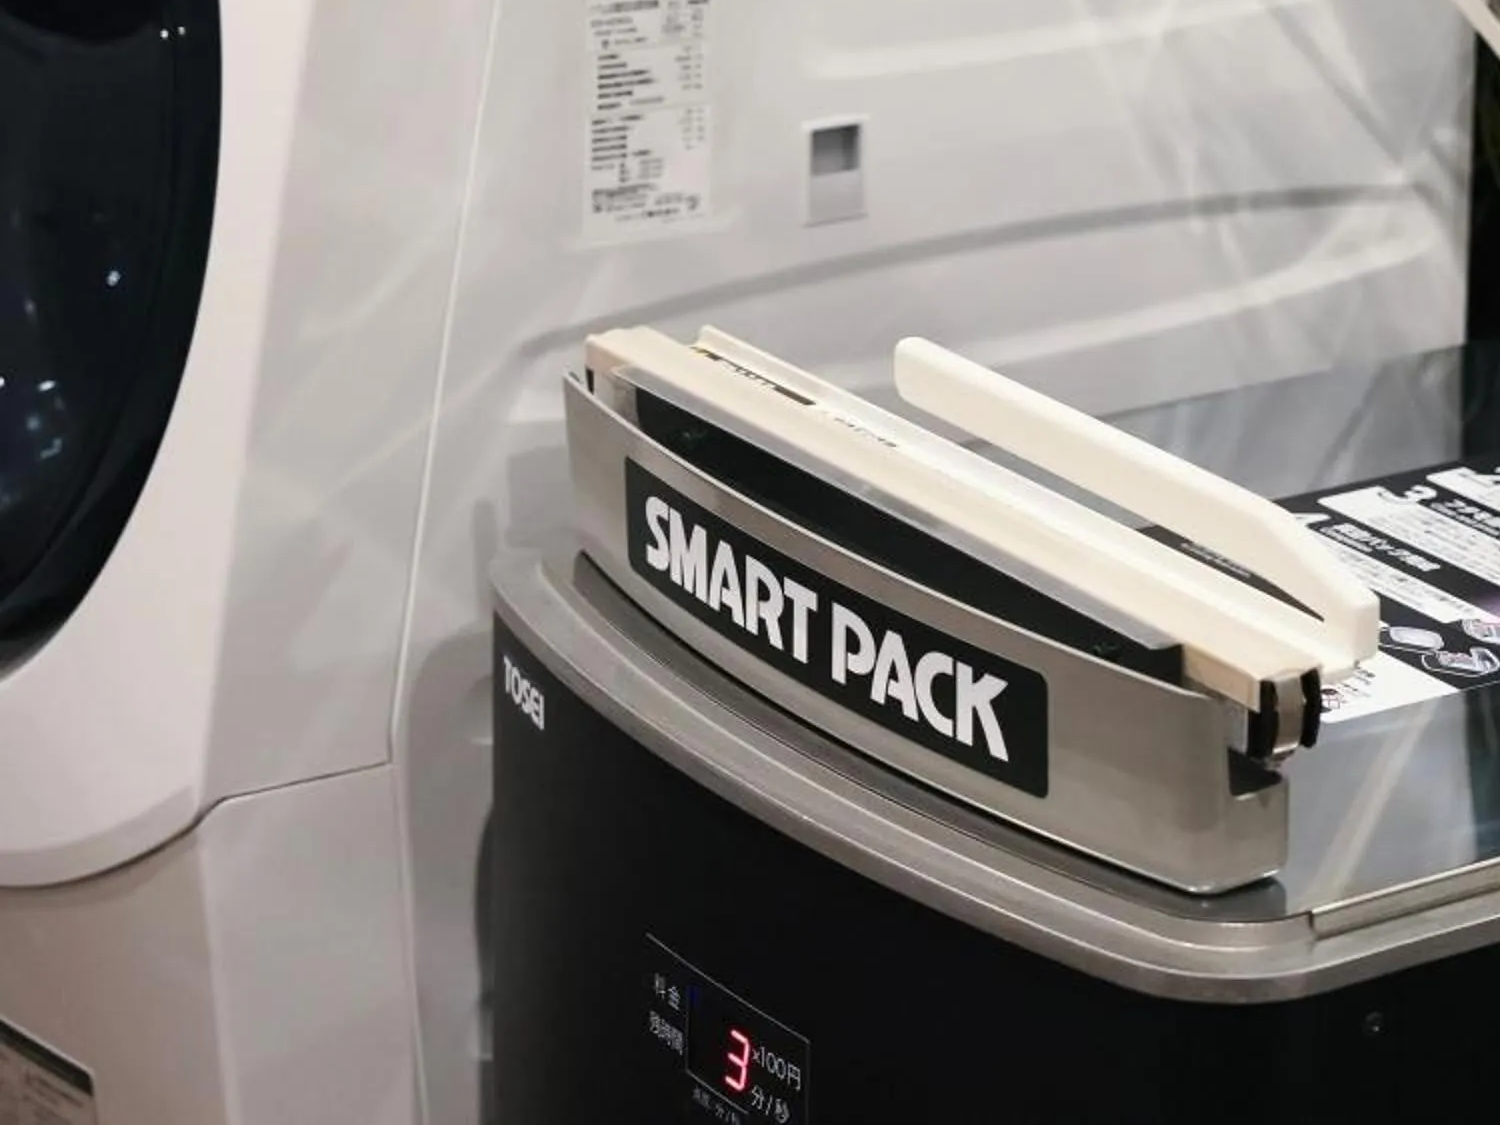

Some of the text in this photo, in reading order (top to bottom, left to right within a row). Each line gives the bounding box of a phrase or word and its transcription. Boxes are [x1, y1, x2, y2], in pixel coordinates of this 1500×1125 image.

[645, 496, 1008, 762] SMART PACK
[503, 655, 544, 730] TOSEI
[725, 1029, 750, 1092] 3
